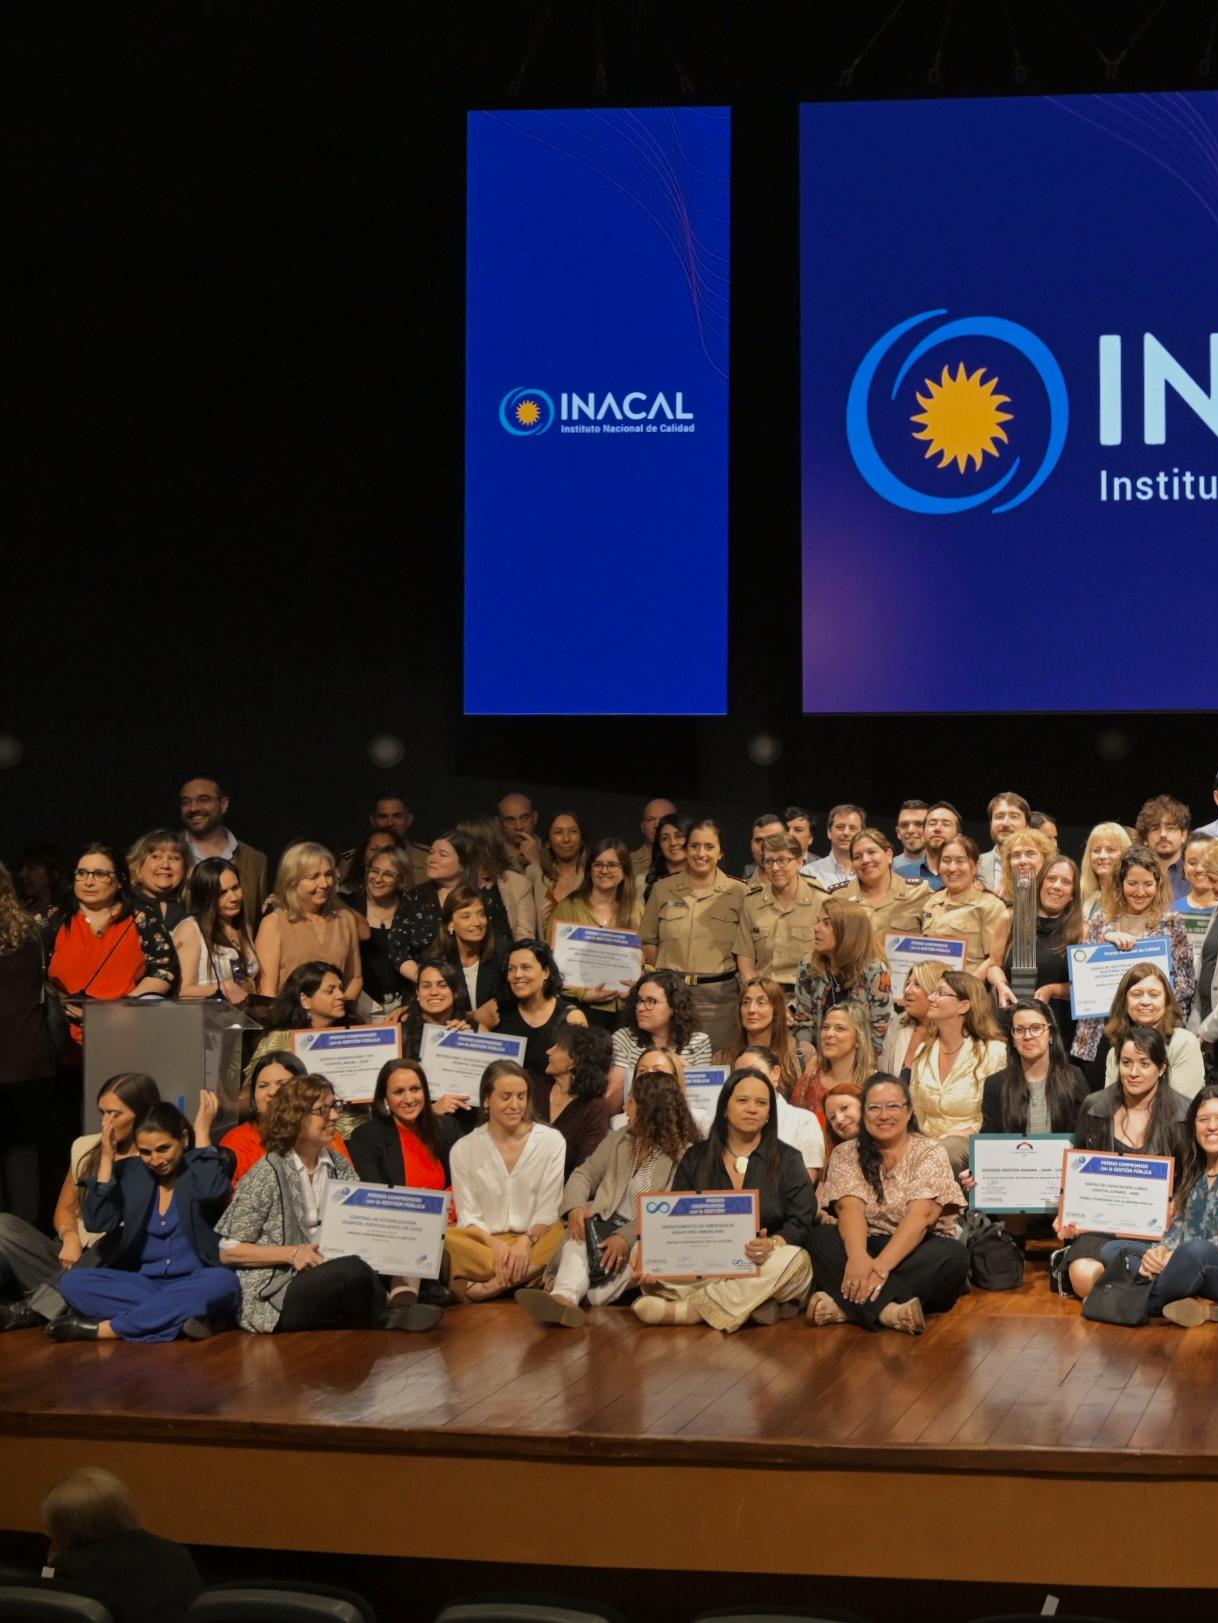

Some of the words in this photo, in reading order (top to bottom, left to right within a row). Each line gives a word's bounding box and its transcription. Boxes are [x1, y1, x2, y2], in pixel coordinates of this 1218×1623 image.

[560, 392, 694, 420] INACAL
[561, 424, 600, 434] Instituto
[603, 424, 643, 433] Nacional
[646, 424, 658, 433] de
[660, 424, 695, 432] Calidad
